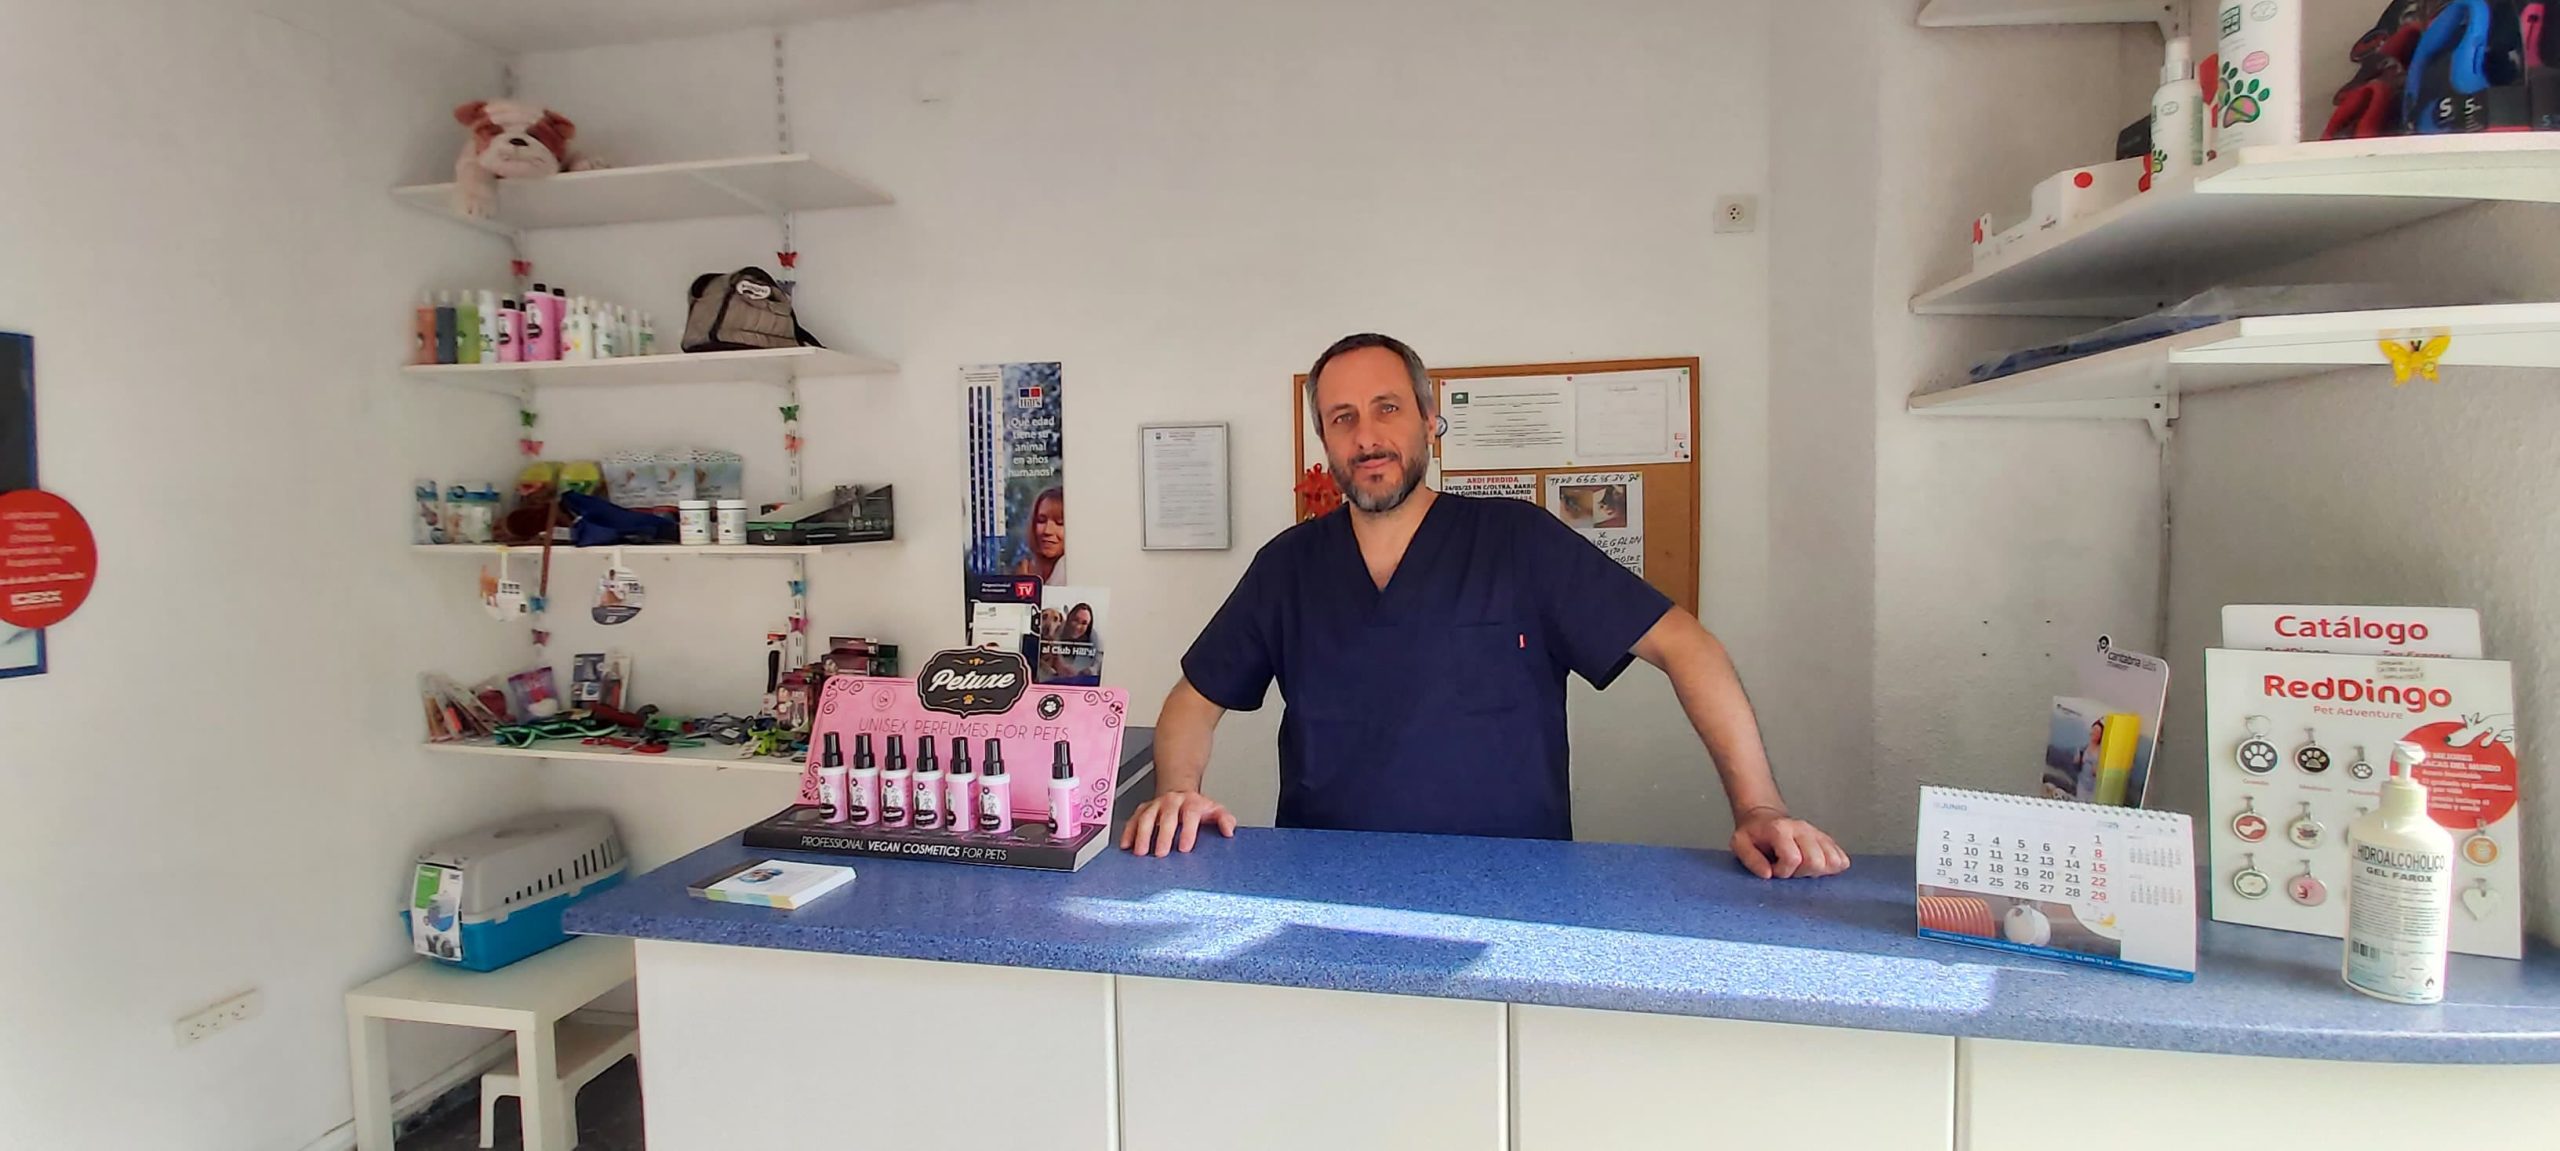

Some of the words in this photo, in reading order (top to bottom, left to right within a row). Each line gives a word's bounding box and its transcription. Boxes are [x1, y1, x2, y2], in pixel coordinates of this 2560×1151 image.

[1031, 416, 1055, 426] edad
[1013, 430, 1037, 439] tiene
[1015, 440, 1047, 452] animal
[1026, 454, 1049, 464] años
[1008, 466, 1055, 477] humanos?
[1018, 586, 1032, 596] TV
[2274, 616, 2429, 645] Catálogo
[1051, 645, 1071, 655] Club
[927, 668, 1017, 693] Petuxe
[2263, 675, 2453, 712] RedDingo
[2314, 706, 2334, 716] Pet
[2336, 706, 2404, 720] Adventure
[858, 718, 907, 733] UNISEX
[914, 720, 989, 738] PERFUMES
[994, 724, 1026, 740] FOR
[1032, 726, 1070, 742] PETS
[1942, 803, 1968, 812] JUNIO
[1943, 830, 1950, 840] 2
[1967, 834, 1975, 842] 3
[1992, 836, 2000, 846] 4
[2018, 840, 2026, 848] 5
[2042, 842, 2050, 852] 6
[2068, 846, 2076, 855] 7
[2094, 849, 2102, 858] 8
[2094, 835, 2102, 844] 1
[801, 836, 864, 850] PROFESSIONAL
[867, 840, 901, 852] VEGAN
[902, 842, 960, 858] COSMETICS
[962, 848, 982, 859] FOR
[984, 848, 1007, 861] PETS
[1942, 844, 1950, 852] 9
[1964, 847, 1978, 856] 10
[1990, 850, 2003, 860] 11
[2015, 853, 2029, 862] 12
[2040, 856, 2054, 866] 13
[2066, 860, 2080, 869] 14
[2092, 863, 2106, 872] 15
[1939, 858, 1952, 866] 16
[1964, 860, 1978, 870] 17
[1990, 864, 2004, 873] 18
[2015, 867, 2029, 876] 19
[2040, 870, 2054, 880] 20
[2066, 874, 2080, 884] 21
[2091, 877, 2106, 886] 22
[2366, 866, 2388, 878] GEL
[2392, 872, 2433, 883] FAROX
[1936, 868, 1946, 876] 23
[1964, 874, 1978, 884] 24
[1989, 877, 2004, 886] 25
[2014, 880, 2029, 890] 26
[2040, 884, 2054, 894] 27
[2065, 888, 2080, 897] 28
[2091, 891, 2106, 900] 29
